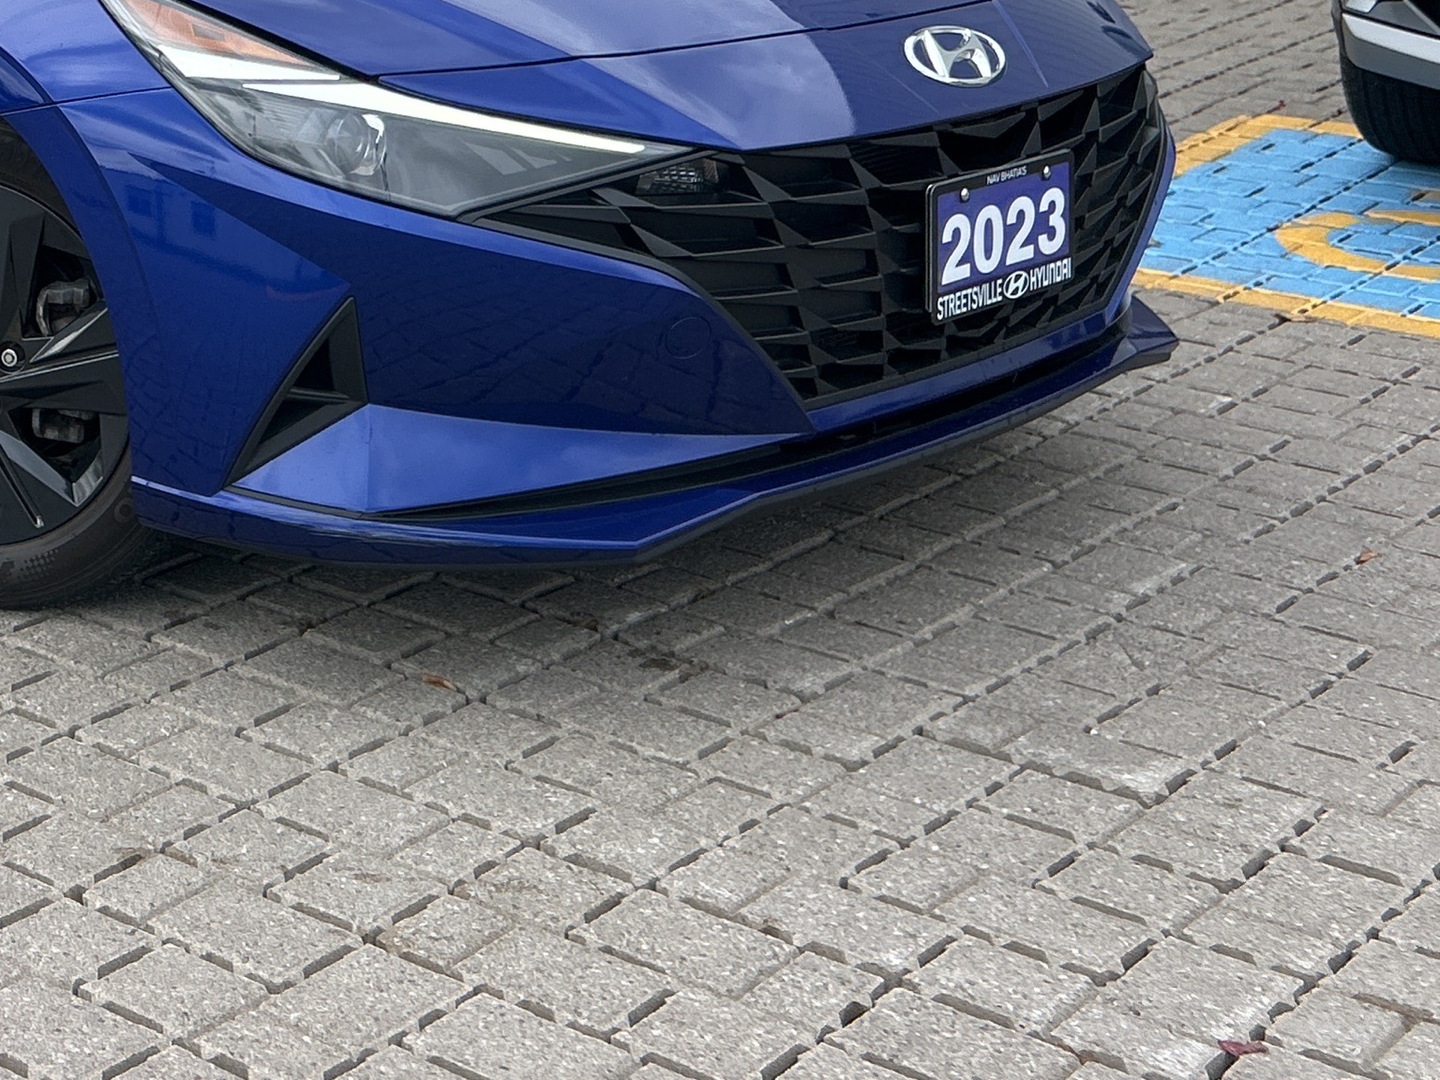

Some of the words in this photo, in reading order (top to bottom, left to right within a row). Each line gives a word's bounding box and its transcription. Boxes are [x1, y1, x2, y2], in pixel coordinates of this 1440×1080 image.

[986, 174, 1001, 185] NAV
[941, 186, 1066, 286] 2023
[936, 278, 1003, 321] STREETSVILLE
[1029, 257, 1072, 292] HYUNDAI
